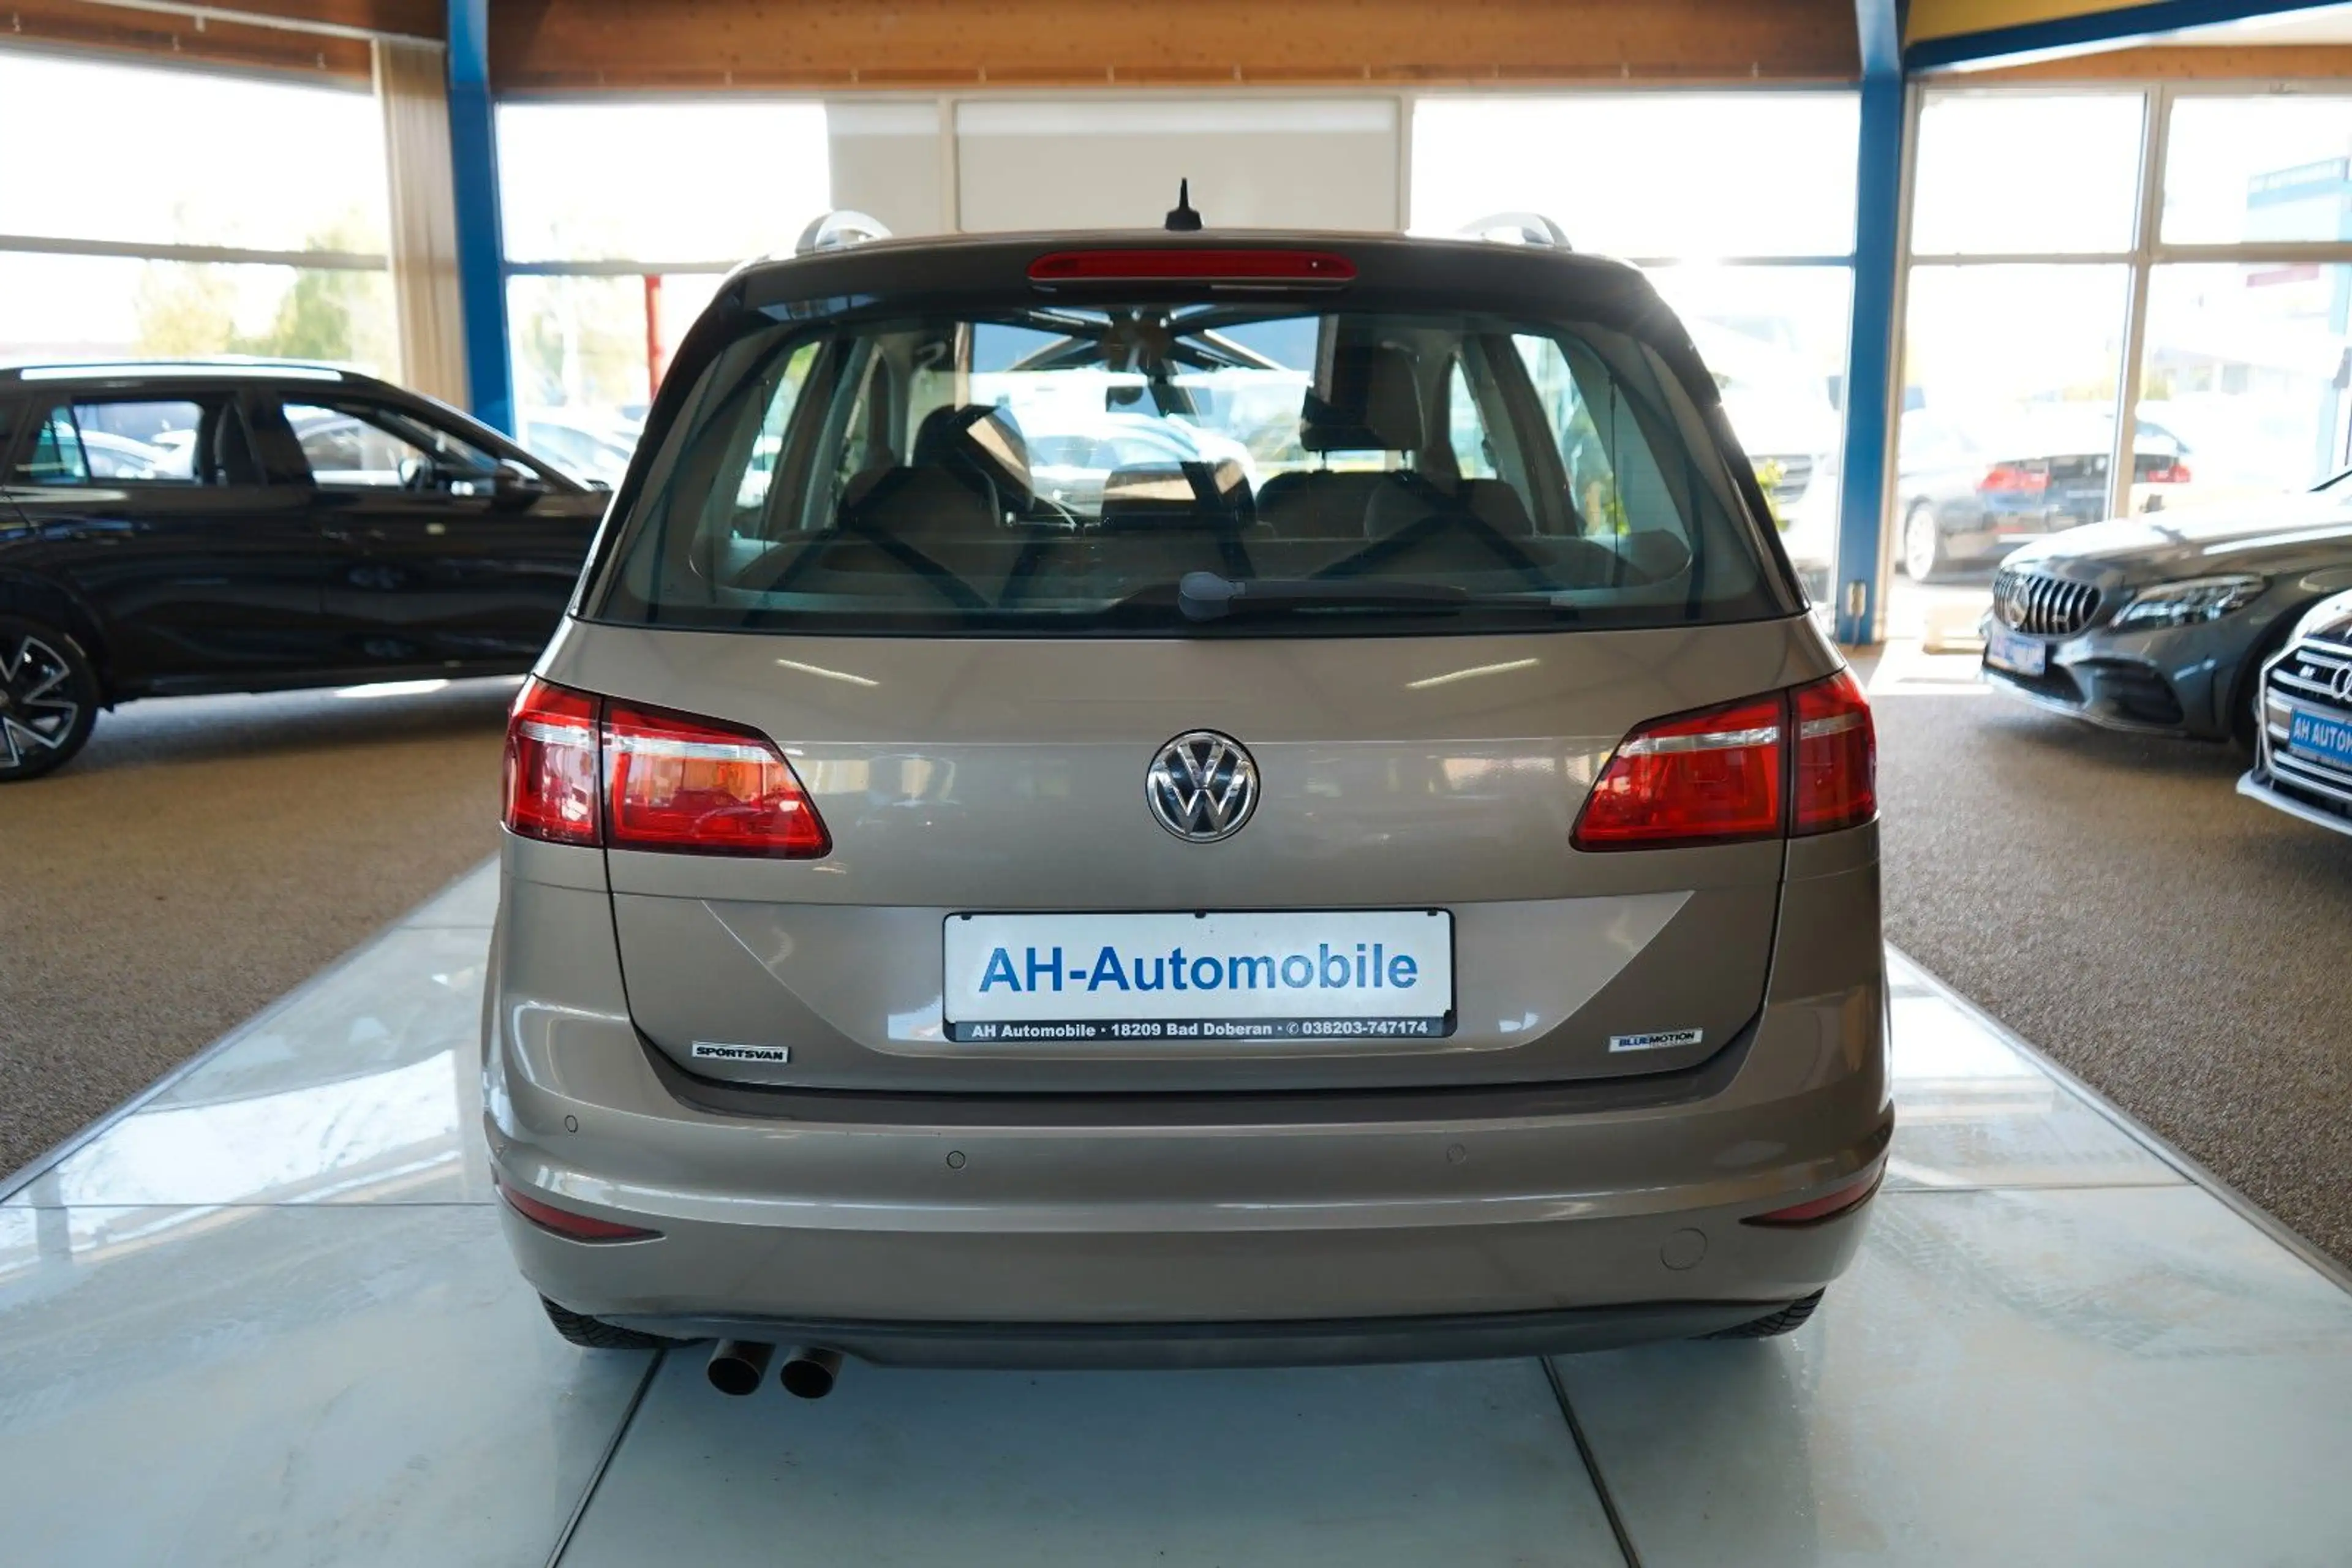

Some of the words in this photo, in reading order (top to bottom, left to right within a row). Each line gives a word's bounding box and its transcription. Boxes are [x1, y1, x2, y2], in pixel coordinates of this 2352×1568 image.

[2293, 717, 2310, 743] AH
[979, 943, 1419, 993] AH-Automobile
[971, 1024, 997, 1038] AH
[1001, 1023, 1096, 1037] Automobile
[1111, 1023, 1161, 1036] 18209
[1166, 1022, 1197, 1036] Bad
[1204, 1022, 1273, 1036] Doberan
[1302, 1021, 1428, 1035] 038203-747174
[1618, 1031, 1695, 1047] BLUEMOTION
[696, 1046, 783, 1061] SPORTSVAN
